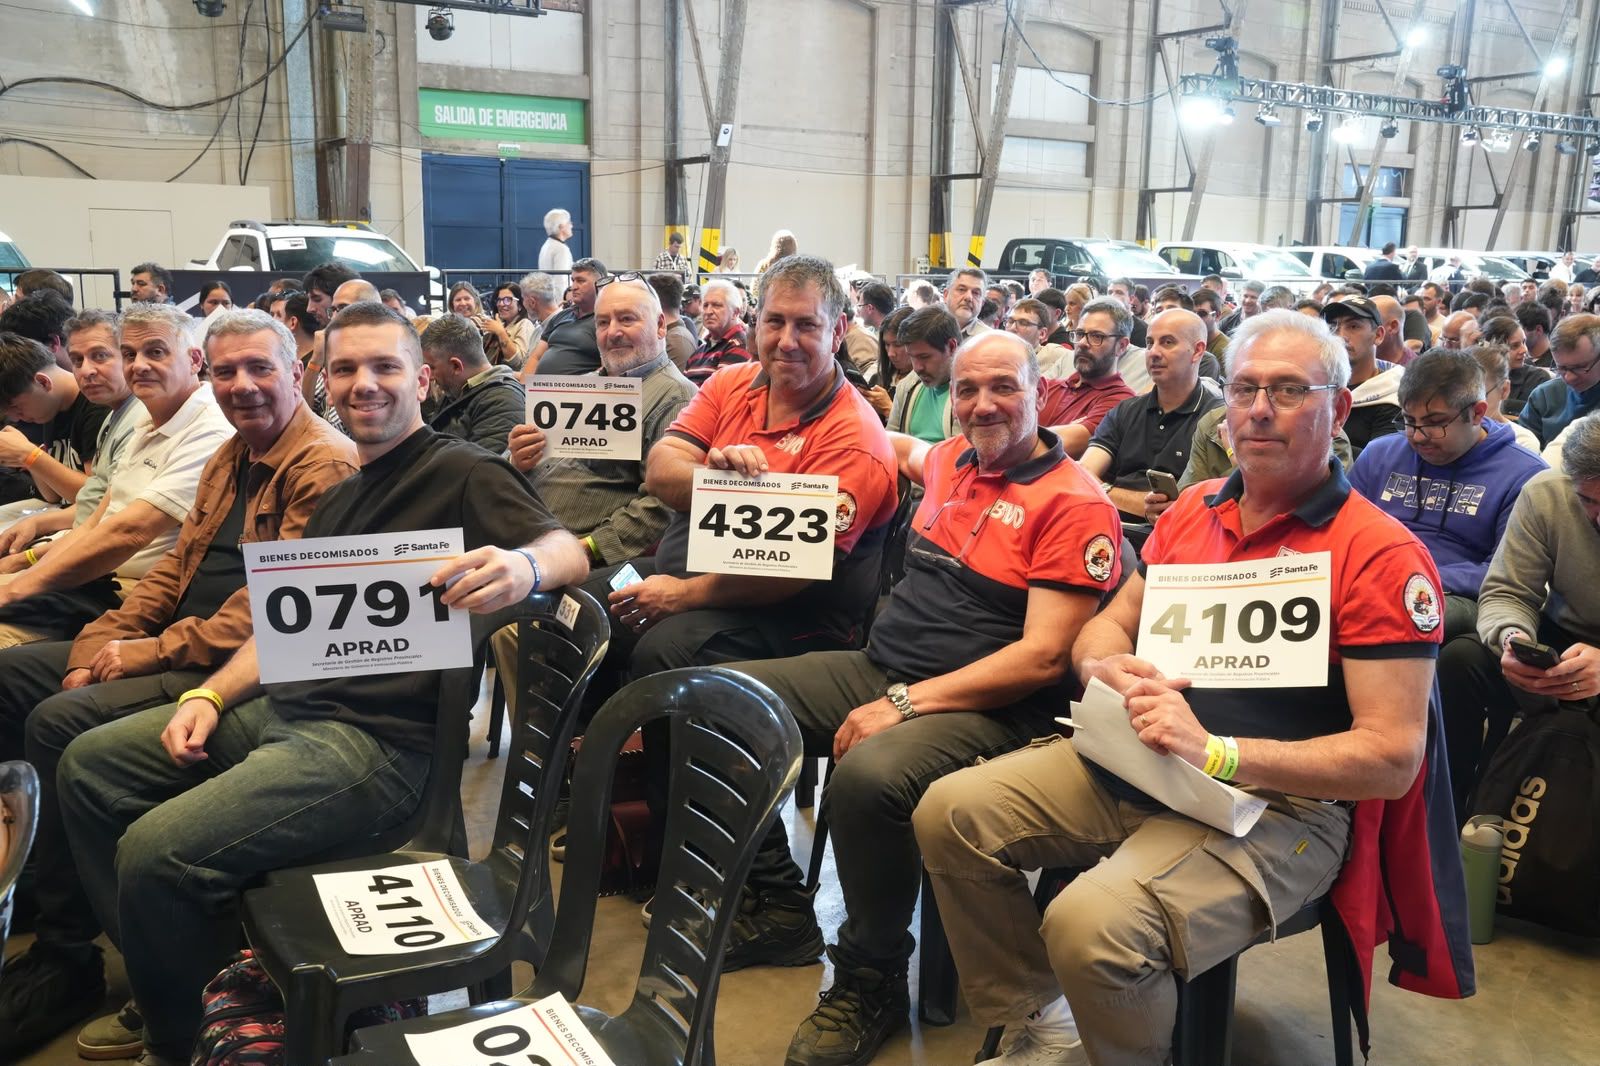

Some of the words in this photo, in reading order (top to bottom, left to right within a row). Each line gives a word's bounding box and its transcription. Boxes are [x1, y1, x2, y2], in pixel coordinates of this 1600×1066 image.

[434, 105, 476, 126] SALIDA
[479, 108, 494, 127] DE
[496, 109, 568, 131] EMERGENCIA
[533, 401, 637, 432] 0748
[561, 437, 608, 447] APRAD
[703, 478, 728, 486] BIENES
[728, 479, 781, 489] DECOMISADOS
[698, 503, 829, 544] 4323
[259, 552, 297, 563] BIENES
[299, 547, 379, 560] DECOMISADOS
[411, 542, 438, 551] Santa
[439, 541, 450, 549] Fe
[732, 548, 791, 562] APRAD
[1191, 571, 1258, 582] DECOMISADOS
[1284, 566, 1308, 574] Santa
[1309, 563, 1319, 571] Fe
[265, 580, 451, 634] 0791
[1150, 596, 1321, 644] 4109
[325, 637, 410, 657] APRAD
[1193, 655, 1271, 669] APRAD
[344, 900, 373, 934] APRAD
[368, 875, 445, 947] 4110
[545, 1008, 568, 1033] BIENES
[564, 1032, 598, 1066] DECOMIS
